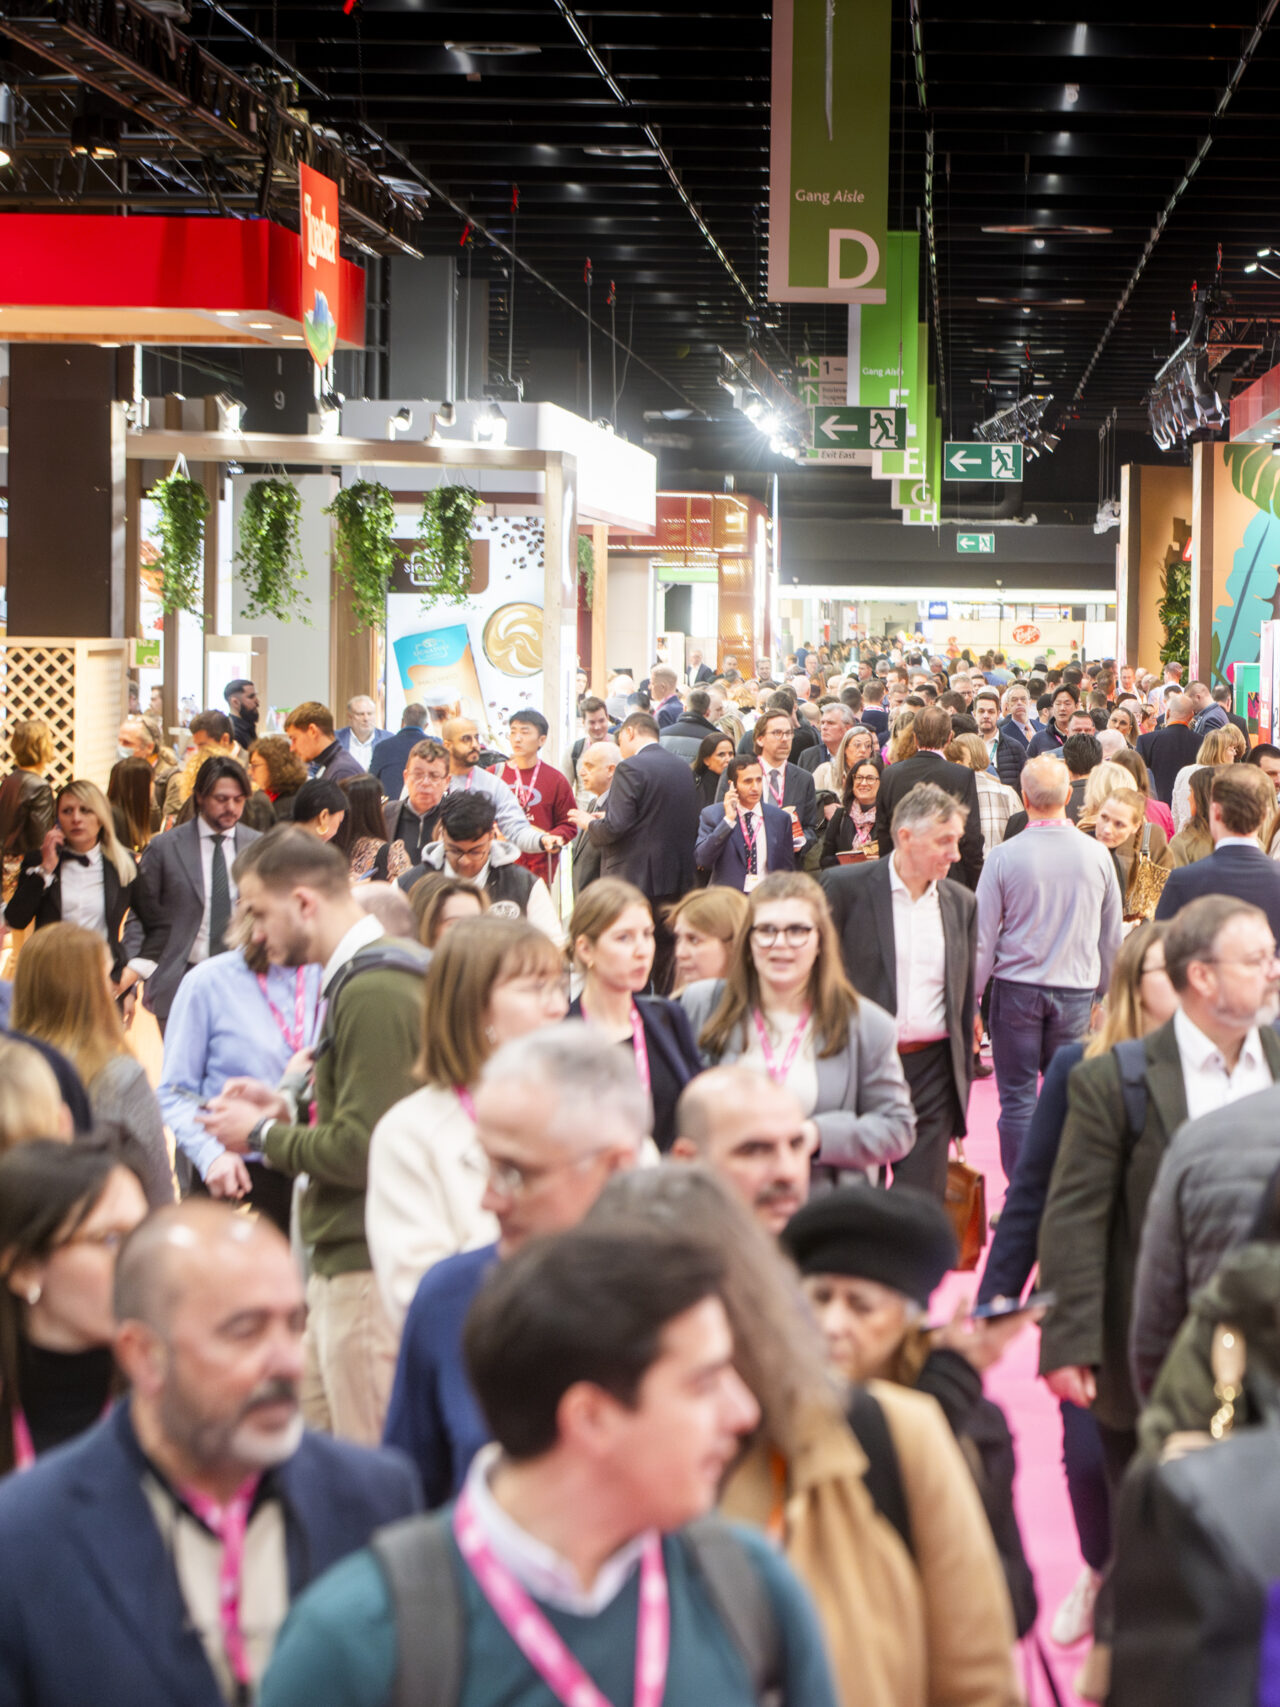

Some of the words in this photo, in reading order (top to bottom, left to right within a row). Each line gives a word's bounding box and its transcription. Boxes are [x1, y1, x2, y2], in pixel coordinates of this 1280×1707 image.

[795, 188, 830, 205] Gang
[833, 189, 865, 203] Aisle
[828, 228, 880, 288] D
[862, 367, 883, 377] Gang
[821, 450, 838, 459] Exit
[840, 450, 856, 460] East
[911, 482, 931, 506] G
